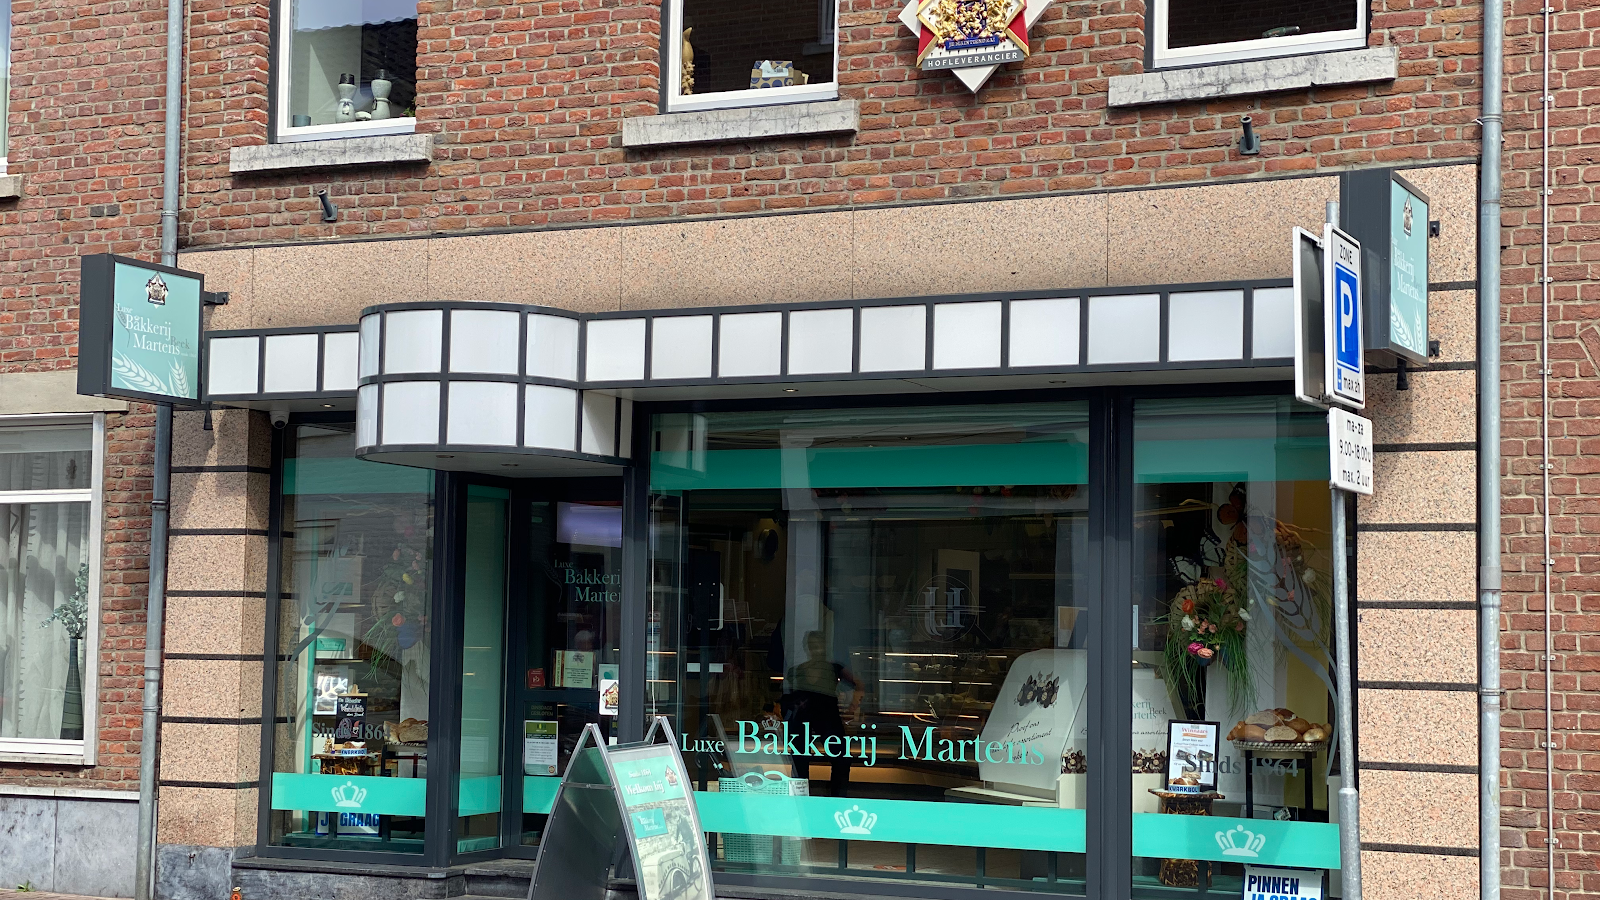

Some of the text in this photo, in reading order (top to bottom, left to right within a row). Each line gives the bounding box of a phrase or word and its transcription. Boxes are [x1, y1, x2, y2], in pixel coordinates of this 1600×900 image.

[927, 52, 1018, 68] HOFLEVERANCIER
[1339, 244, 1353, 265] ZONE
[1340, 280, 1354, 353] P
[125, 314, 171, 340] Bakkerij
[133, 333, 180, 355] Martens
[1346, 419, 1364, 436] ma-za
[1356, 470, 1361, 485] 2
[1361, 475, 1370, 488] uur
[554, 559, 574, 568] Luxe
[564, 568, 621, 585] Bakkeri
[574, 586, 621, 602] Marte
[311, 721, 352, 739] Sinds
[681, 720, 1045, 767] Luxe Bakkerij Martens
[1184, 754, 1299, 778] Sinds 1864
[624, 780, 665, 796] Welkom bij
[1247, 874, 1300, 895] PINNEN
